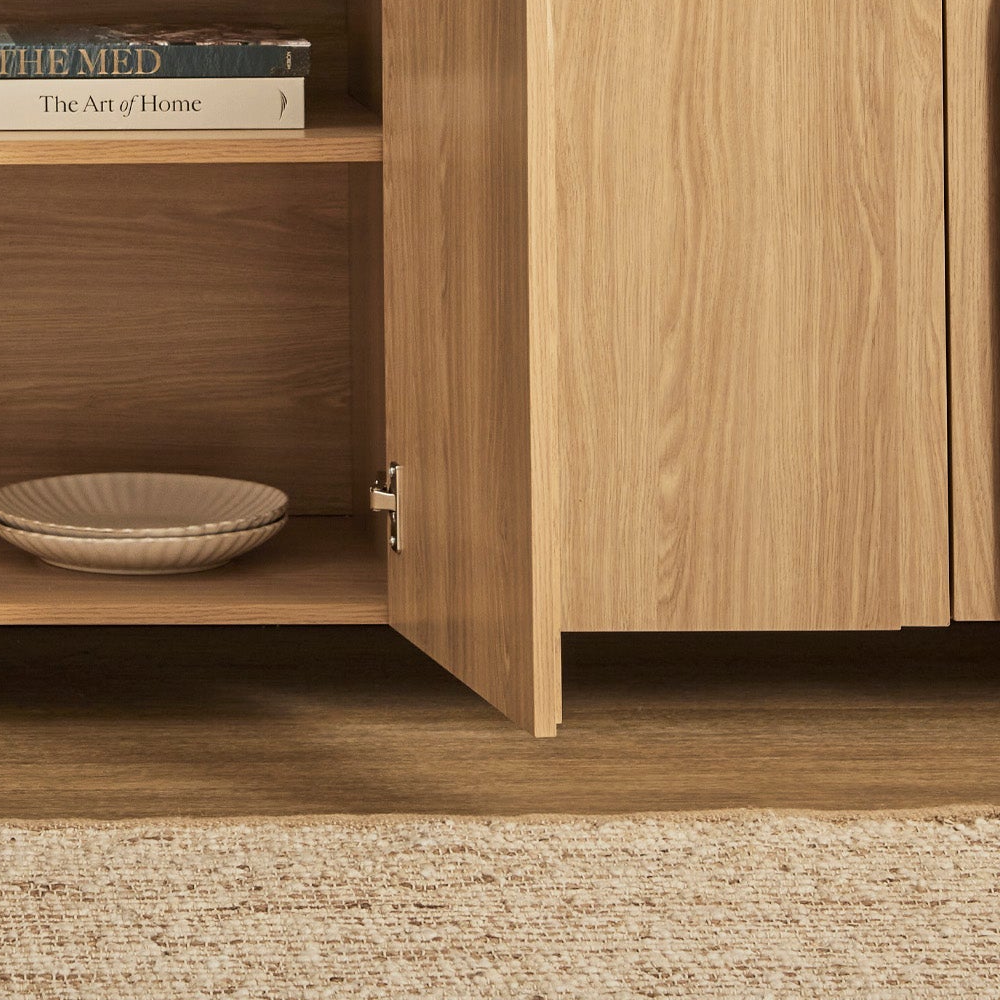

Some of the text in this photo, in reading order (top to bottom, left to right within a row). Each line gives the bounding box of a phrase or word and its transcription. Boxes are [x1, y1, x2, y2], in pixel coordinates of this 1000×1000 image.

[77, 48, 162, 76] MED
[39, 94, 202, 118] The Art of Home
